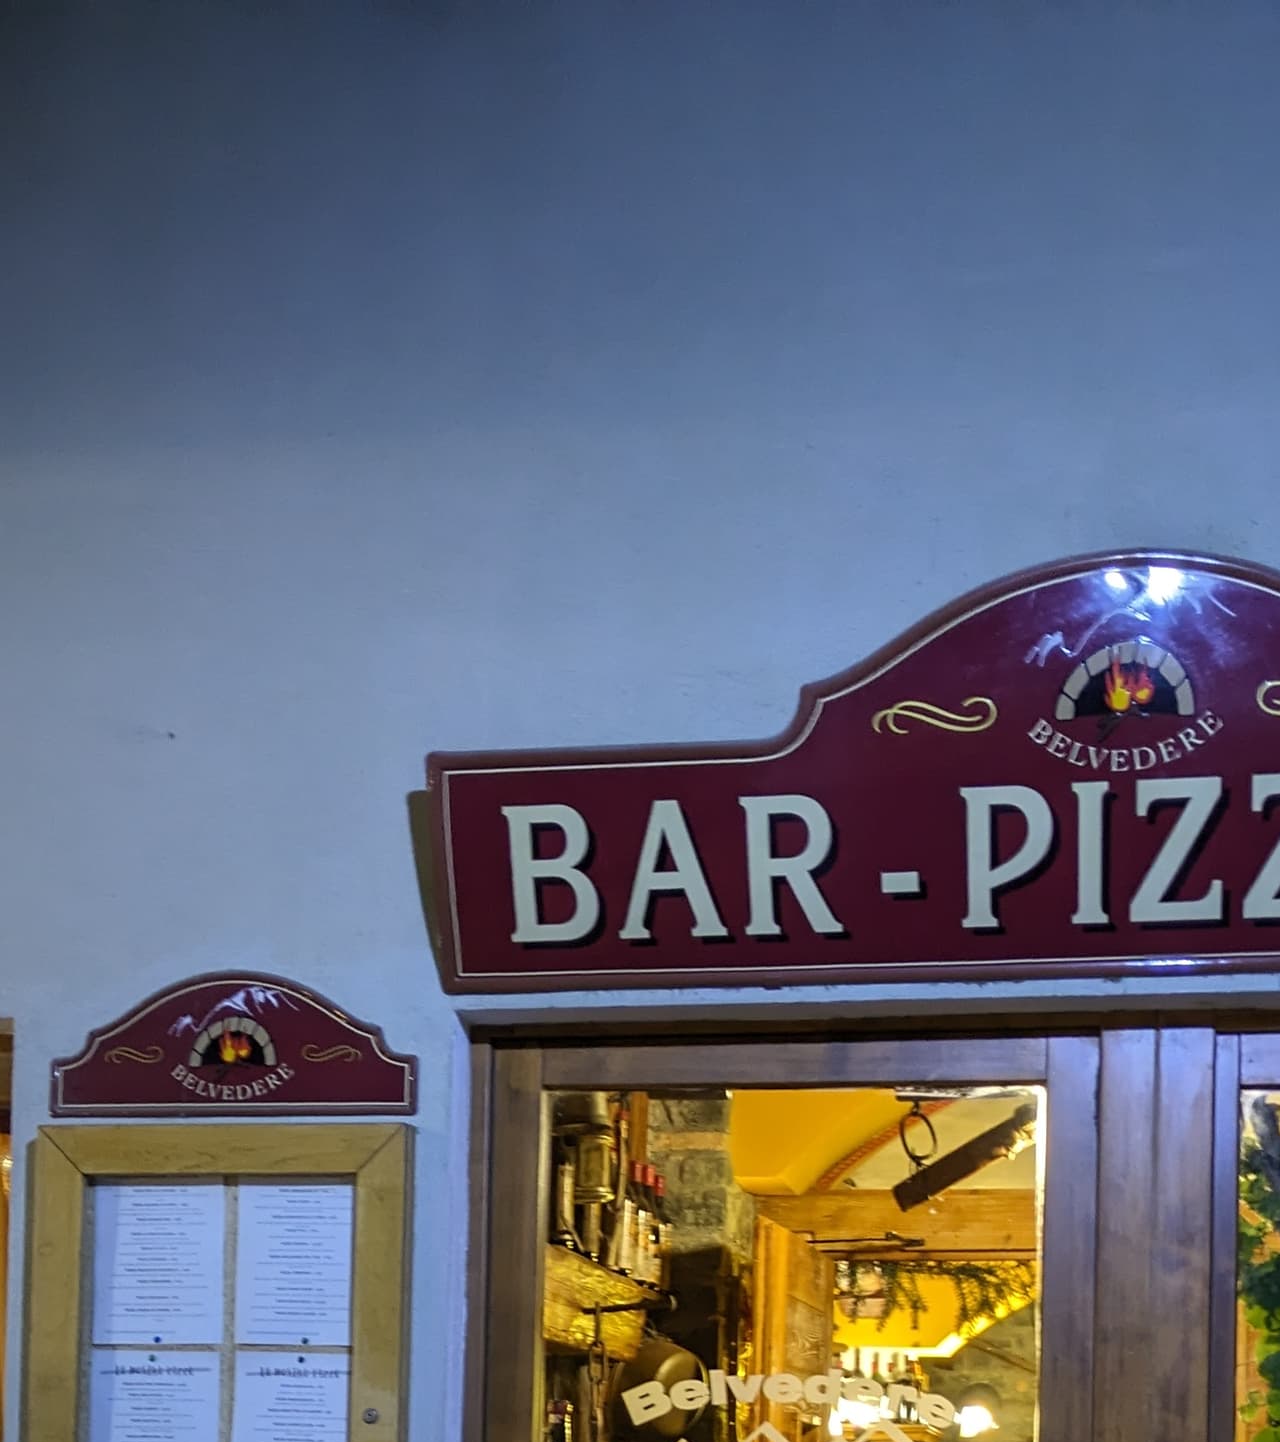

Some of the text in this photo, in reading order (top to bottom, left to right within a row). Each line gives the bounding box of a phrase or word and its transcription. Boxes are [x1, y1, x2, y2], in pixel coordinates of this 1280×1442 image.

[1027, 709, 1224, 772] BELVEDERE
[502, 792, 844, 945] BAR
[169, 1062, 296, 1102] BELVEDERE
[621, 1368, 957, 1429] Belvedere
